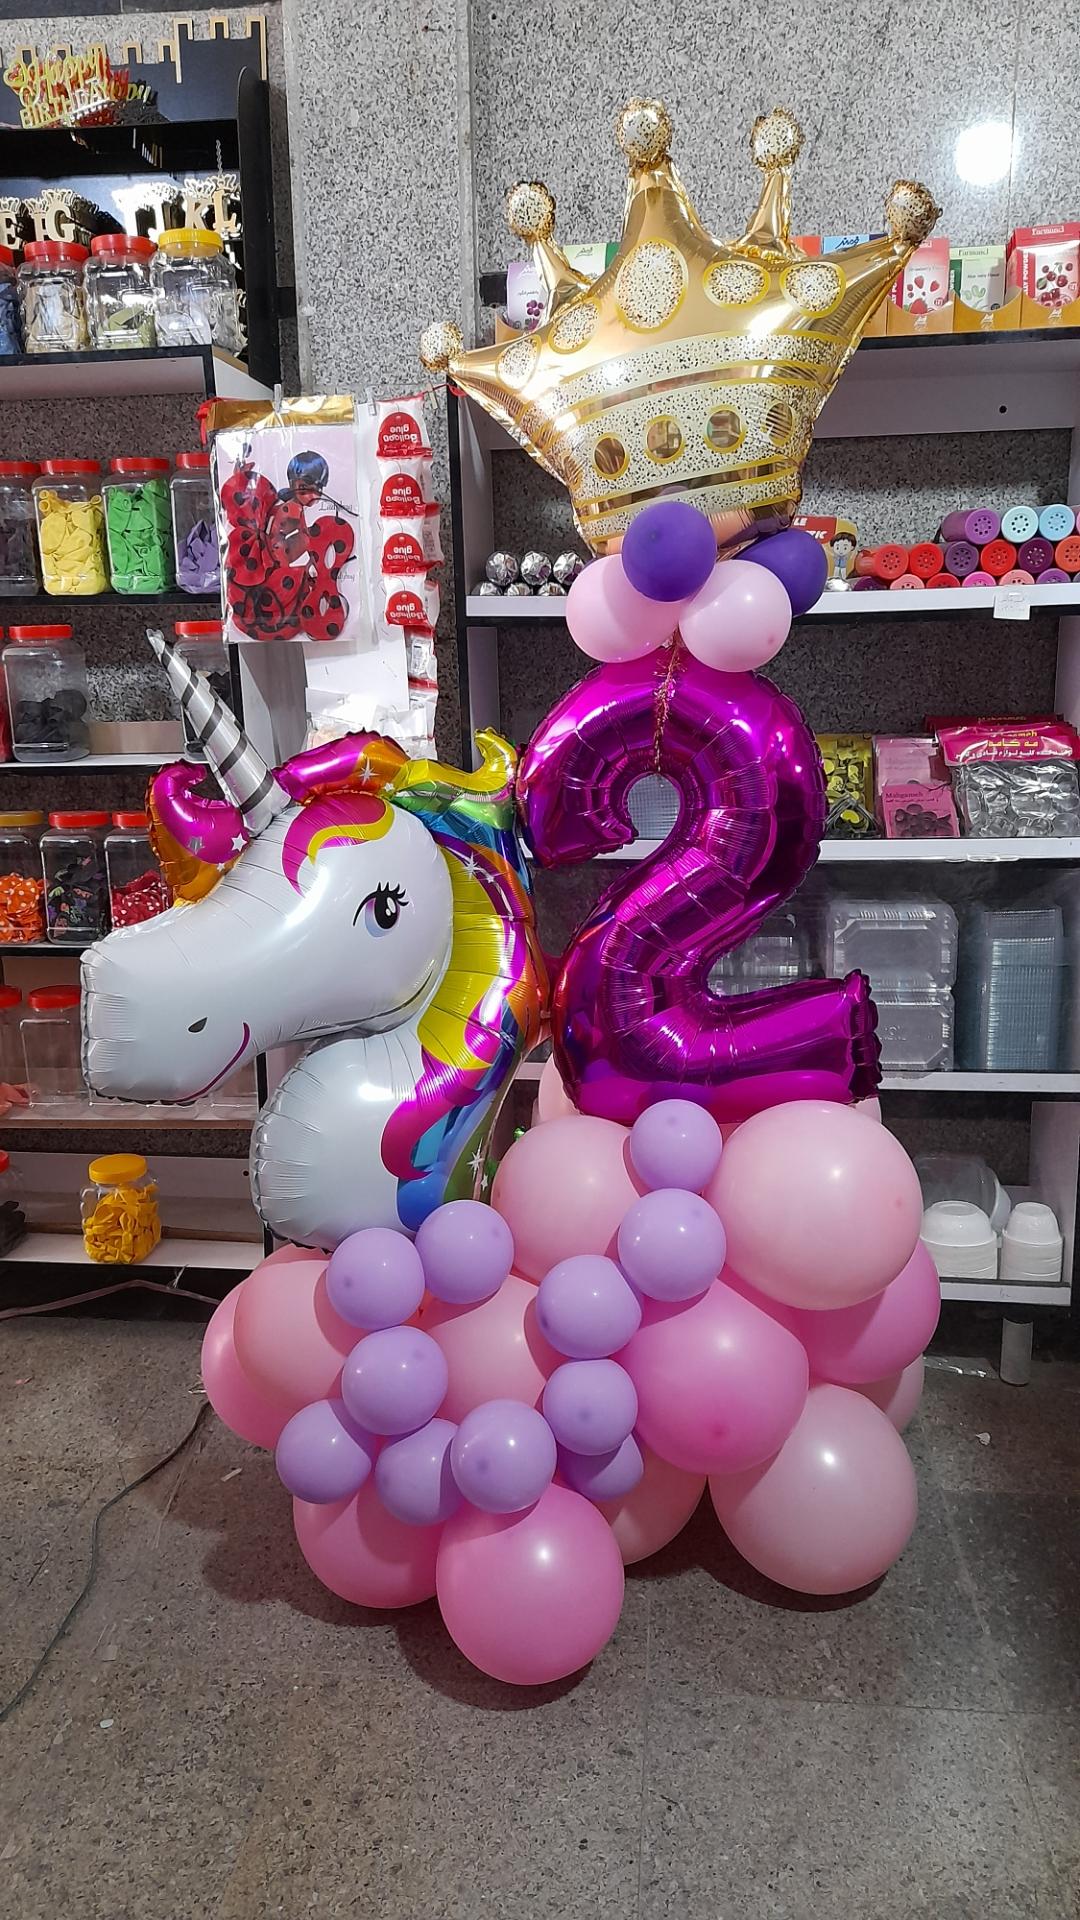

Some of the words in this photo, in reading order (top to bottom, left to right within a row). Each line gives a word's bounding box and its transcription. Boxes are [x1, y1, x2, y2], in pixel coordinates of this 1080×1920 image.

[46, 205, 76, 242] G
[212, 190, 238, 233] L
[390, 424, 409, 433] glue
[392, 486, 412, 496] glue
[393, 545, 413, 555] glue
[396, 603, 415, 612] glue
[519, 662, 882, 1118] 2
